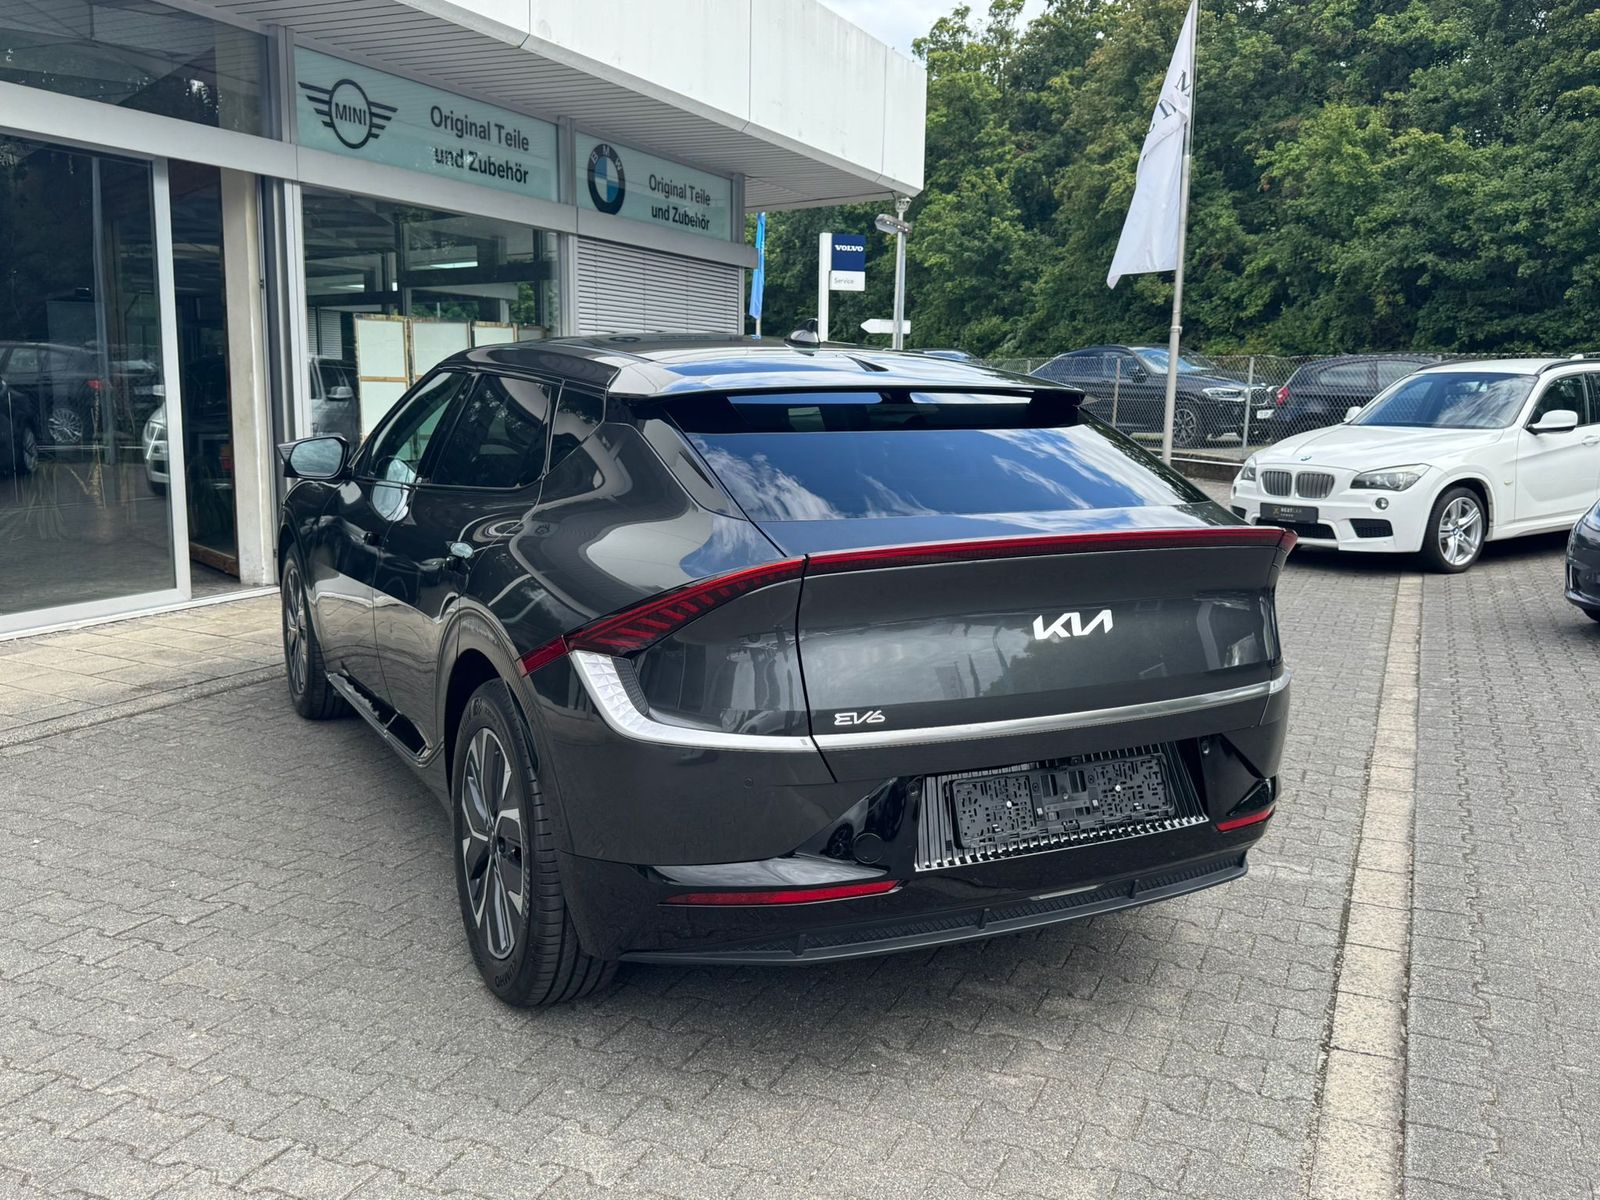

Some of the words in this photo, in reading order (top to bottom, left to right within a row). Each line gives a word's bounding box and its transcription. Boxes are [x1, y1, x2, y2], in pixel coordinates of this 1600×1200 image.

[334, 102, 368, 127] MINI
[430, 105, 491, 141] Original
[494, 124, 530, 152] Teile
[434, 147, 465, 169] und
[467, 151, 529, 185] Zubehör
[591, 145, 622, 170] BMW
[649, 174, 687, 200] Original
[688, 185, 711, 207] Teile
[651, 204, 670, 221] und
[671, 206, 711, 231] Zubehör
[834, 244, 864, 252] VOLVO
[834, 277, 855, 285] Service
[1032, 609, 1114, 640] KIA
[834, 710, 886, 726] EV6
